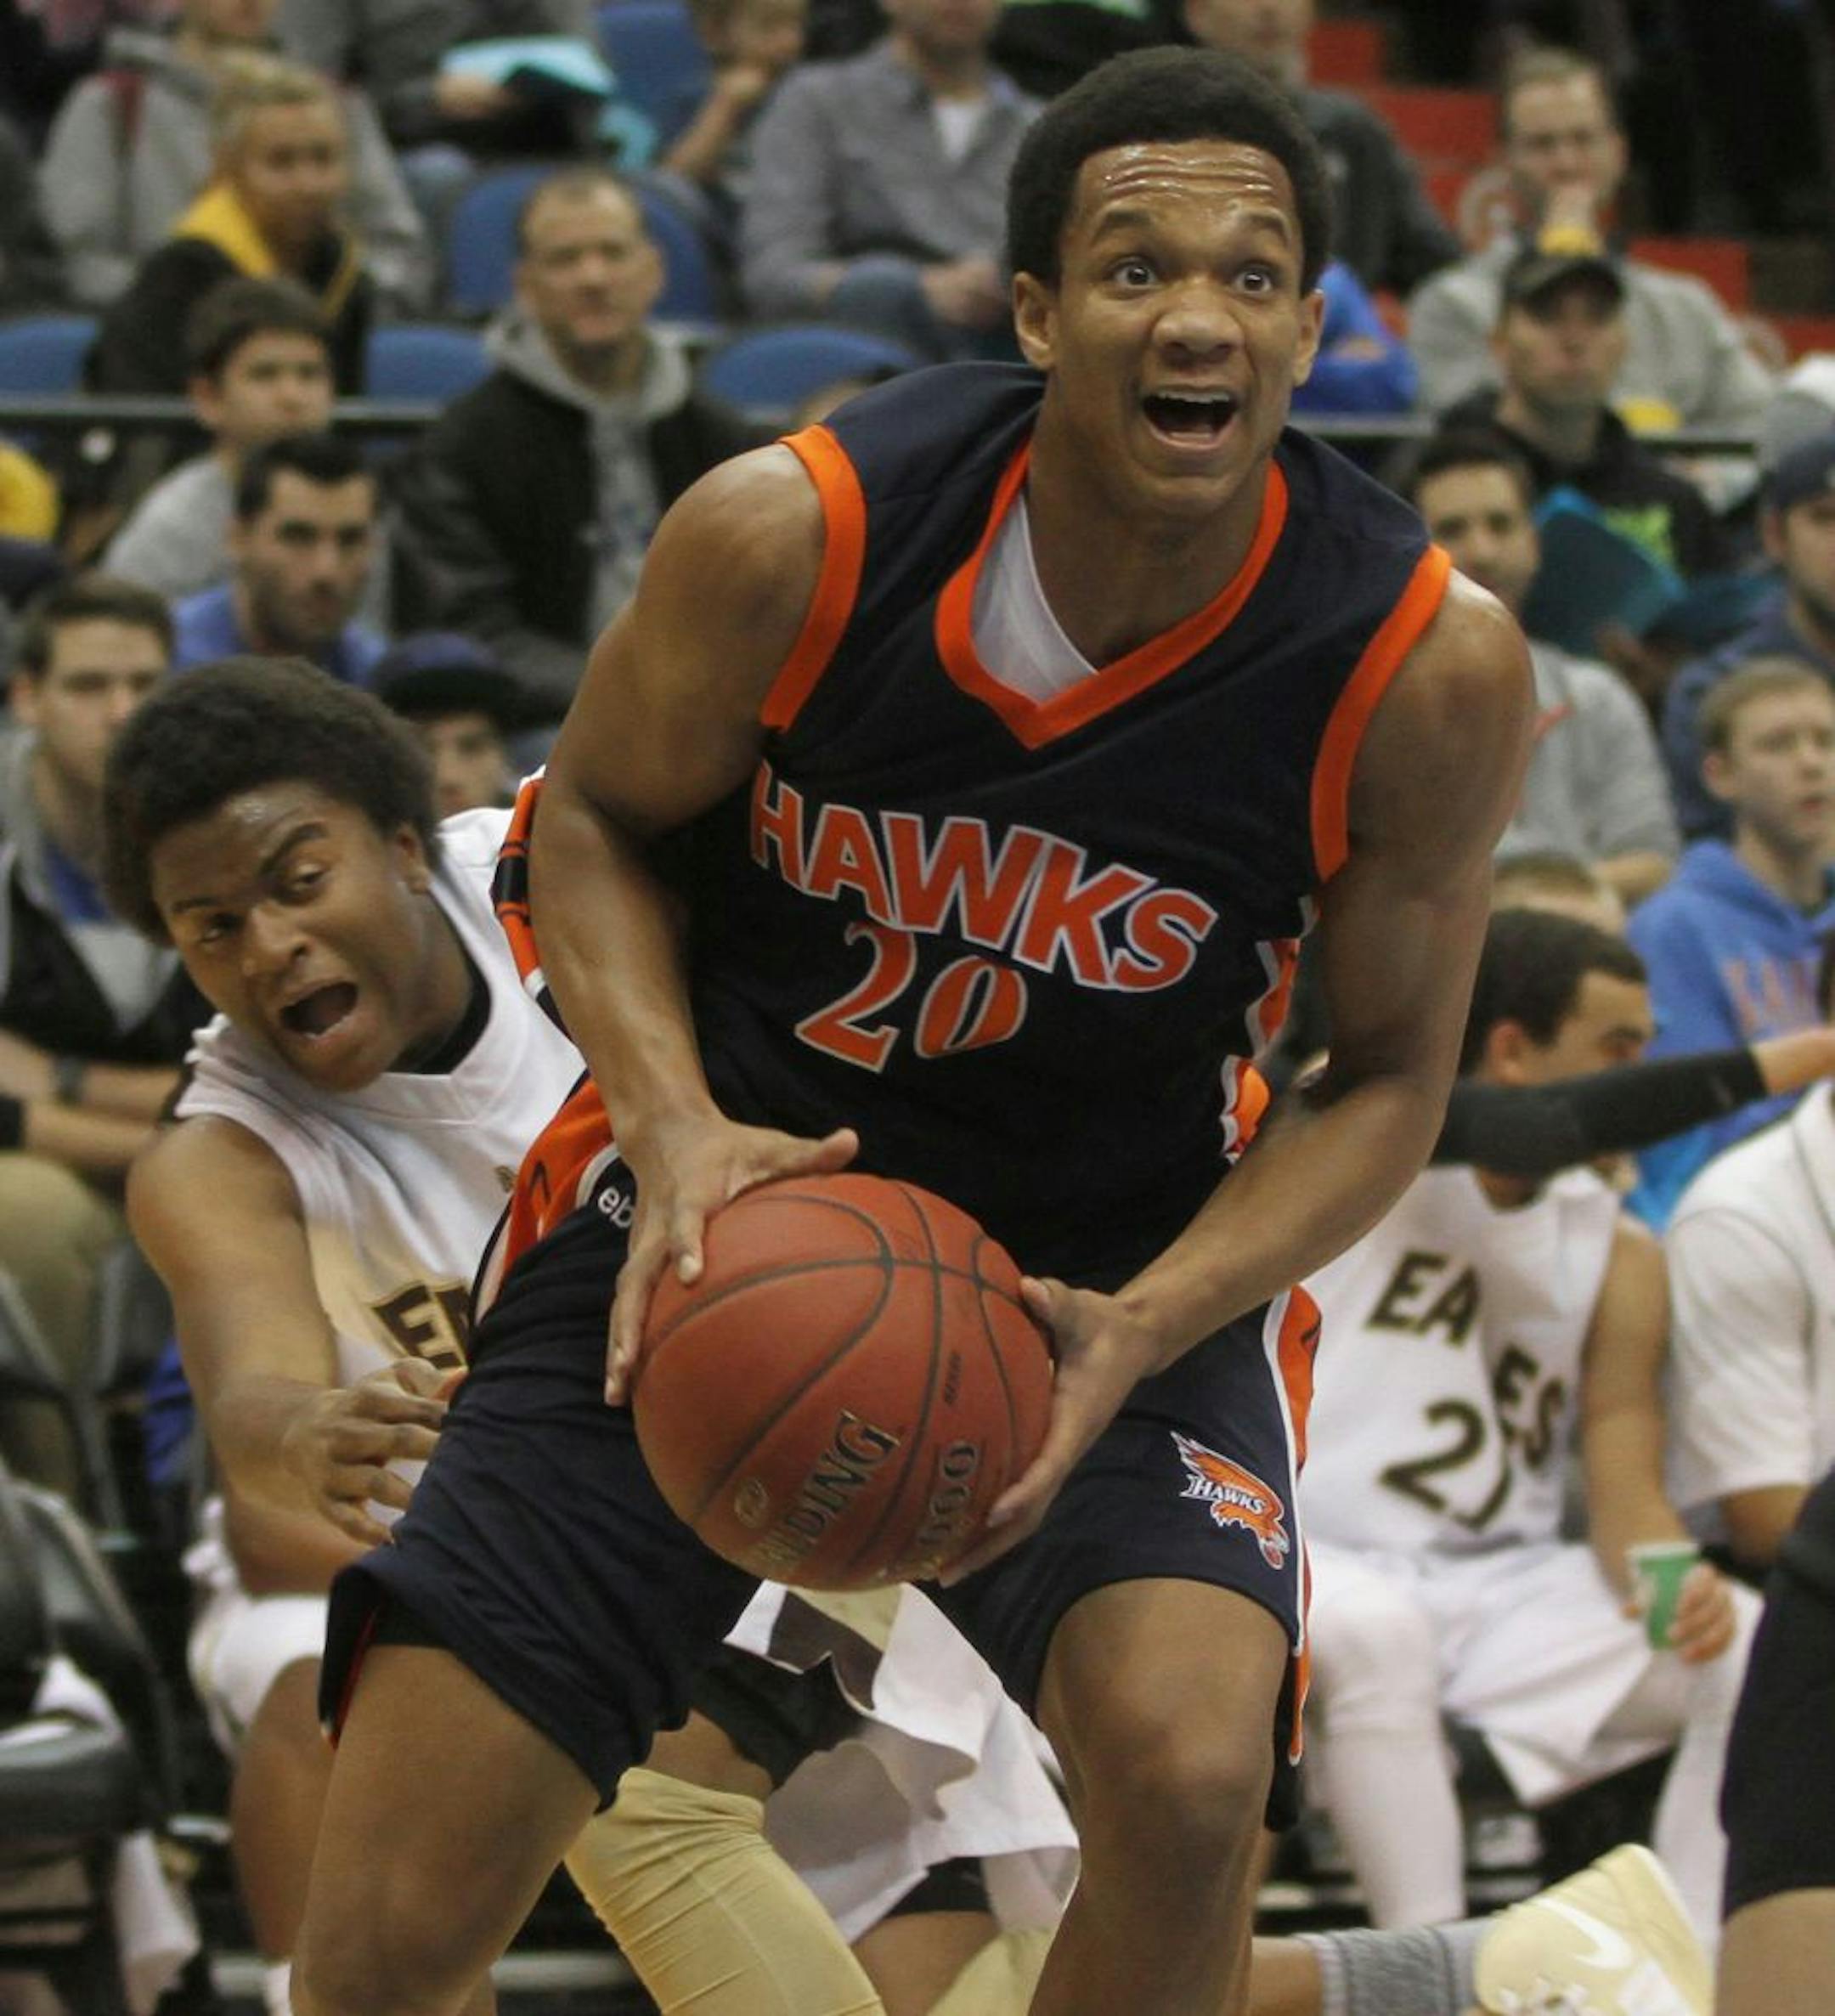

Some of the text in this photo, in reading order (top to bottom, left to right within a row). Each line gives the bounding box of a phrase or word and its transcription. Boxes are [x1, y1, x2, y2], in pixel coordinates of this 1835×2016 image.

[750, 757, 1219, 993] HAWKS
[793, 921, 1028, 1074] 20
[1179, 1473, 1267, 1515] HAWKS
